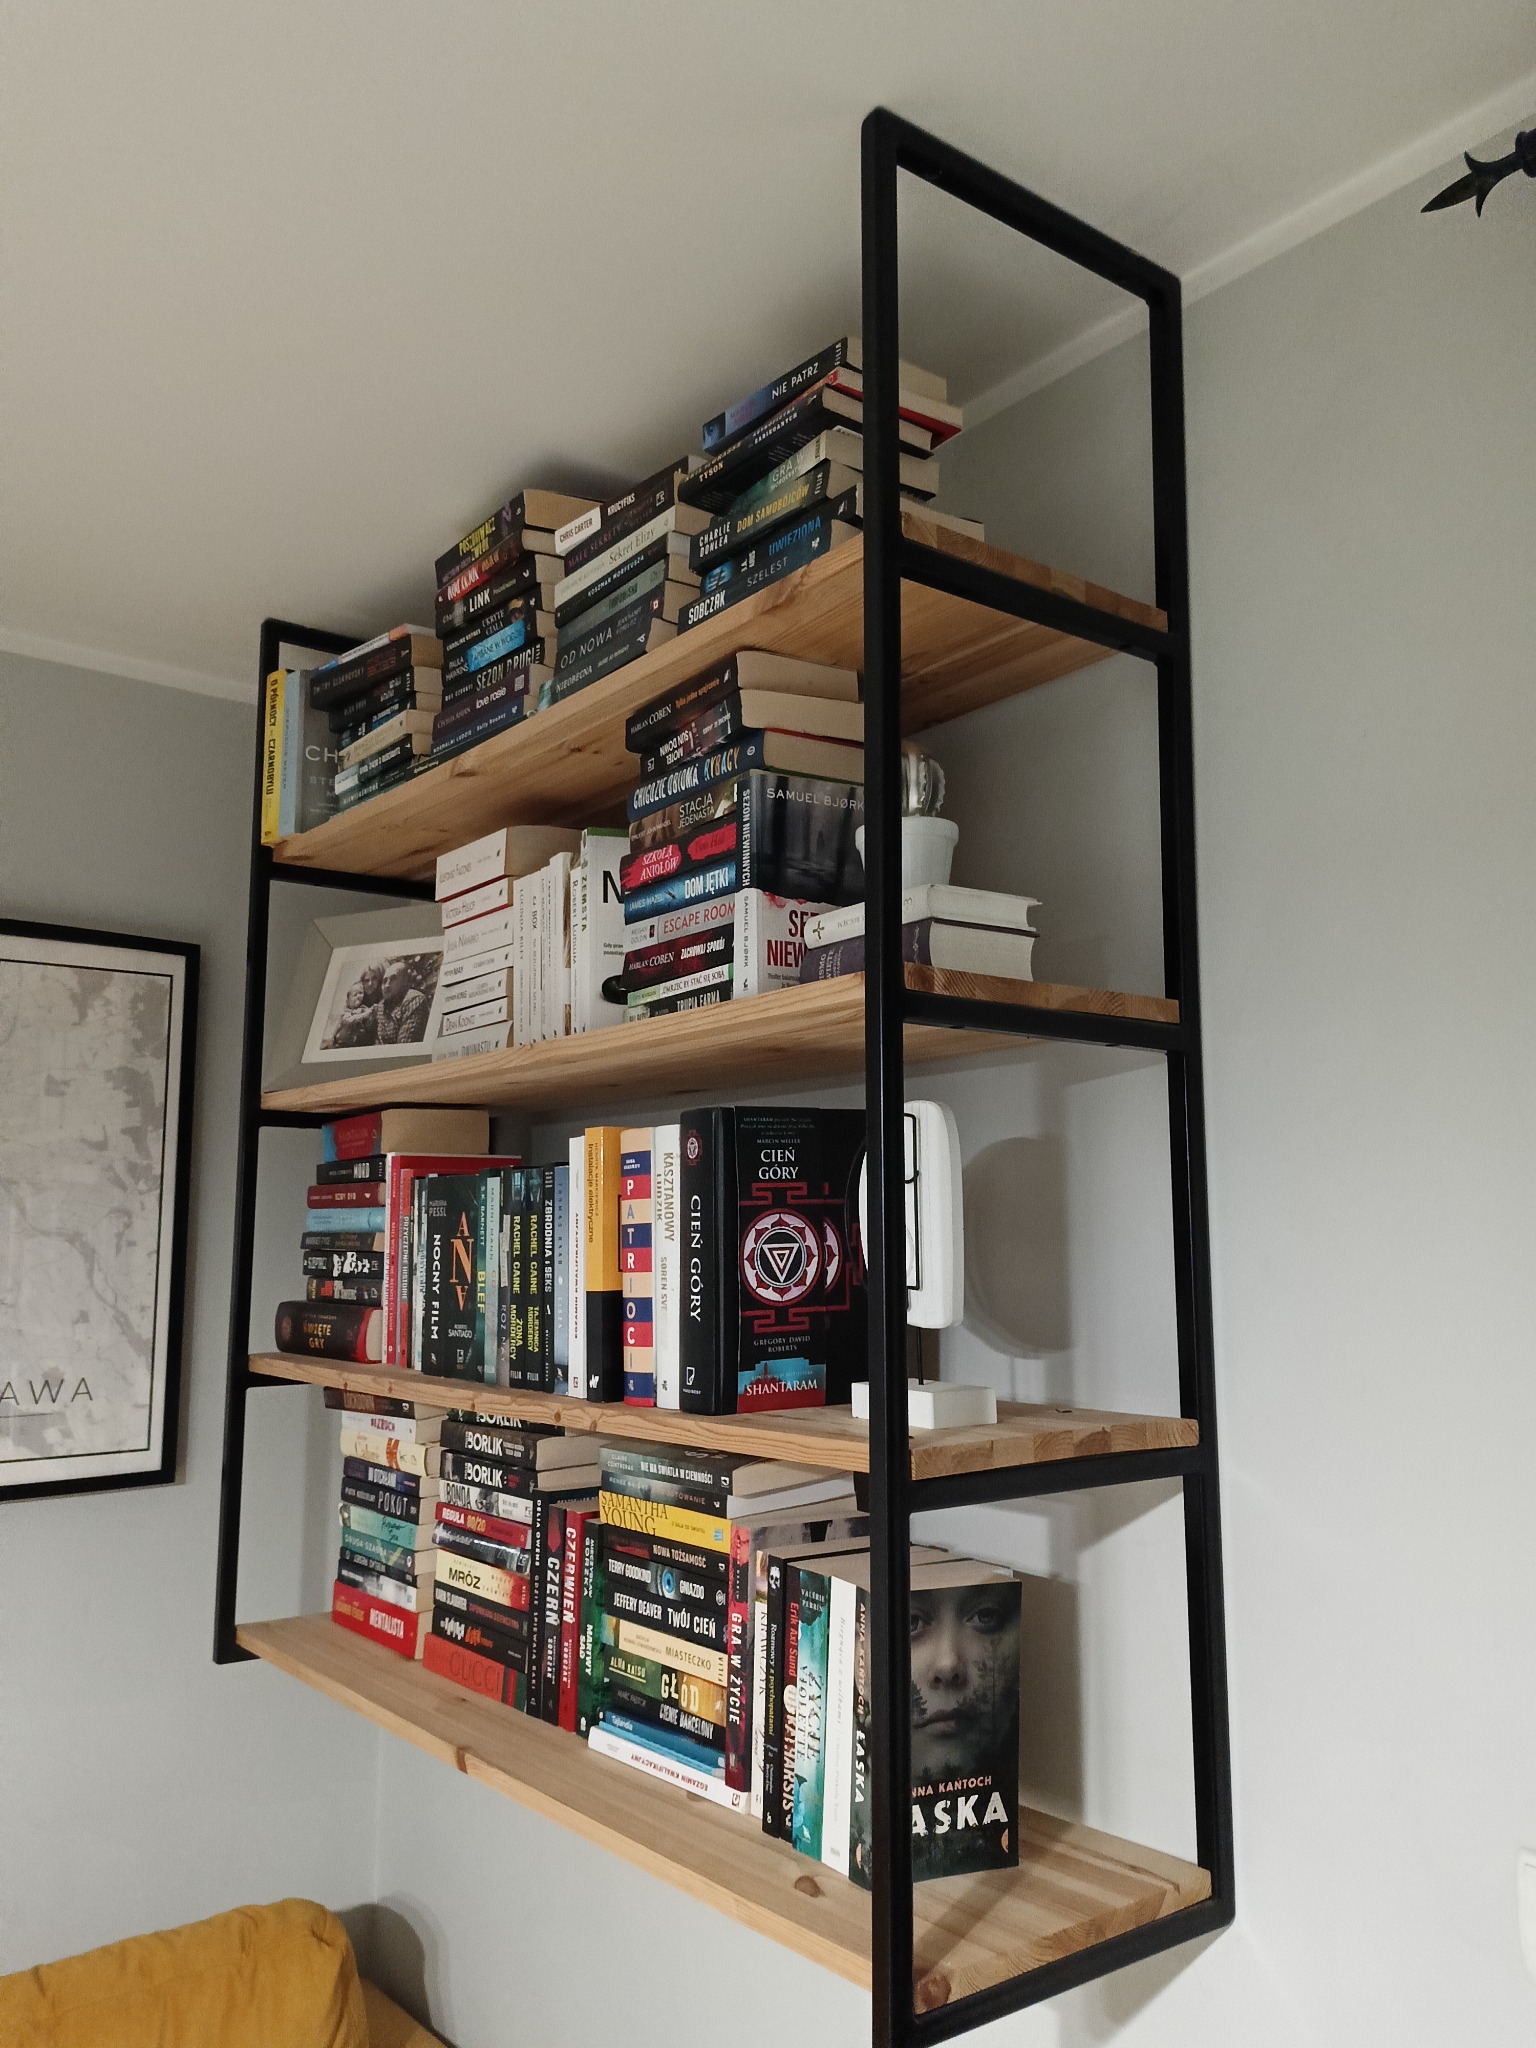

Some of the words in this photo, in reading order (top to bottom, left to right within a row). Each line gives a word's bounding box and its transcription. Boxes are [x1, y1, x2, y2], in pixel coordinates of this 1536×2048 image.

[771, 381, 788, 400] NIE
[791, 362, 819, 389] PATRZ
[698, 461, 725, 483] TYSON
[772, 457, 793, 483] GRA
[559, 530, 574, 544] CHRIS
[574, 517, 593, 535] CARTER
[699, 521, 731, 548] CHARLIE
[736, 515, 754, 534] DOM
[608, 540, 634, 565] Sekret
[699, 534, 729, 558] DONLEA
[746, 557, 789, 588] SZELEST
[469, 588, 491, 613] LINK
[688, 589, 727, 625] SOBCZAK
[560, 650, 576, 669] OD
[579, 627, 613, 658] NOWA
[476, 663, 504, 692] SEZON
[648, 703, 672, 725] COBEN
[703, 746, 740, 782] RYBACY
[680, 792, 713, 818] STACJA
[742, 789, 750, 823] SEZON
[766, 787, 820, 805] SAMUEL
[824, 795, 865, 811] BJØRK
[678, 806, 715, 829] JEDENASTA
[642, 844, 673, 866] SZKOŁA
[742, 823, 750, 887] NIEWINNYCH
[685, 874, 703, 899] DOM
[705, 867, 729, 895] JĘTKI
[580, 874, 588, 933] ZEMSTA
[663, 910, 701, 935] ESCAPE
[649, 951, 675, 967] COBEN
[760, 1146, 795, 1163] CIEŃ
[758, 1164, 799, 1180] GÓRY
[663, 1152, 674, 1242] KASZTANOWY
[513, 1215, 521, 1257] RACHEL
[530, 1214, 538, 1257] RACHEL
[544, 1199, 553, 1257] ZBRODNIA
[690, 1195, 703, 1249] CIEŃ
[432, 1234, 441, 1295] NOCNY
[512, 1262, 521, 1294] CAINE
[530, 1261, 538, 1294] CAINE
[477, 1270, 486, 1314] BLEF
[544, 1266, 552, 1293] SEKS
[689, 1259, 702, 1323] GÓRY
[431, 1302, 439, 1340] FILM
[448, 1327, 473, 1339] SANTIAGO
[509, 1304, 517, 1361] MORDERCY
[753, 1337, 788, 1346] GREGORY
[788, 1335, 811, 1343] DAVID
[767, 1344, 798, 1353] ROBERTS
[510, 1370, 522, 1380] FILIA
[746, 1379, 818, 1397] SHANTARAM
[468, 1431, 503, 1457] BORLIK
[468, 1462, 503, 1489] BORLIK
[640, 1461, 650, 1472] NIE
[649, 1463, 658, 1474] MA
[679, 1468, 685, 1479] W
[685, 1470, 713, 1485] CIEMNOŚCI
[602, 1491, 668, 1520] SAMANTHA
[602, 1505, 656, 1536] YOUNG
[652, 1544, 671, 1558] NOWA
[671, 1548, 707, 1569] TOŻSAMOŚĆ
[449, 1567, 481, 1590] MRÓZ
[562, 1527, 577, 1624] CZERWIEŃ
[608, 1559, 625, 1574] TERRY
[625, 1564, 652, 1584] GOODKIND
[680, 1580, 705, 1600] GNIAZDO
[545, 1556, 561, 1626] CZERŃ
[801, 1589, 825, 1603] VALÉRIE
[613, 1592, 638, 1612] JEFFERY
[638, 1599, 662, 1620] DEAVER
[667, 1607, 691, 1629] TWÓJ
[693, 1616, 716, 1639] CIEŃ
[790, 1602, 799, 1625] Erik
[802, 1600, 824, 1613] PERRIN
[731, 1612, 742, 1650] GRA
[769, 1624, 777, 1666] Rozmowy
[789, 1628, 798, 1646] Axl
[585, 1624, 593, 1677] MARTWY
[610, 1656, 626, 1672] ALMA
[665, 1646, 712, 1671] MIASTECZKO
[730, 1654, 742, 1668] W
[788, 1648, 798, 1677] Sund
[449, 1651, 500, 1693] GUCCI
[857, 1645, 866, 1714] KANTOCH
[661, 1673, 699, 1712] GŁÓD
[728, 1674, 742, 1726] ŻYCIE
[768, 1675, 776, 1736] psychopatami
[611, 1715, 633, 1731] Tajlandia
[659, 1703, 679, 1725] CIENIE
[679, 1712, 714, 1740] BARCELONY
[631, 1753, 680, 1779] KWALIFIKACYJNY
[854, 1729, 866, 1803] ŁASKA
[681, 1774, 709, 1792] EGZAMIN
[938, 1775, 993, 1793] KANTOCH
[911, 1791, 1009, 1838] ASKA
